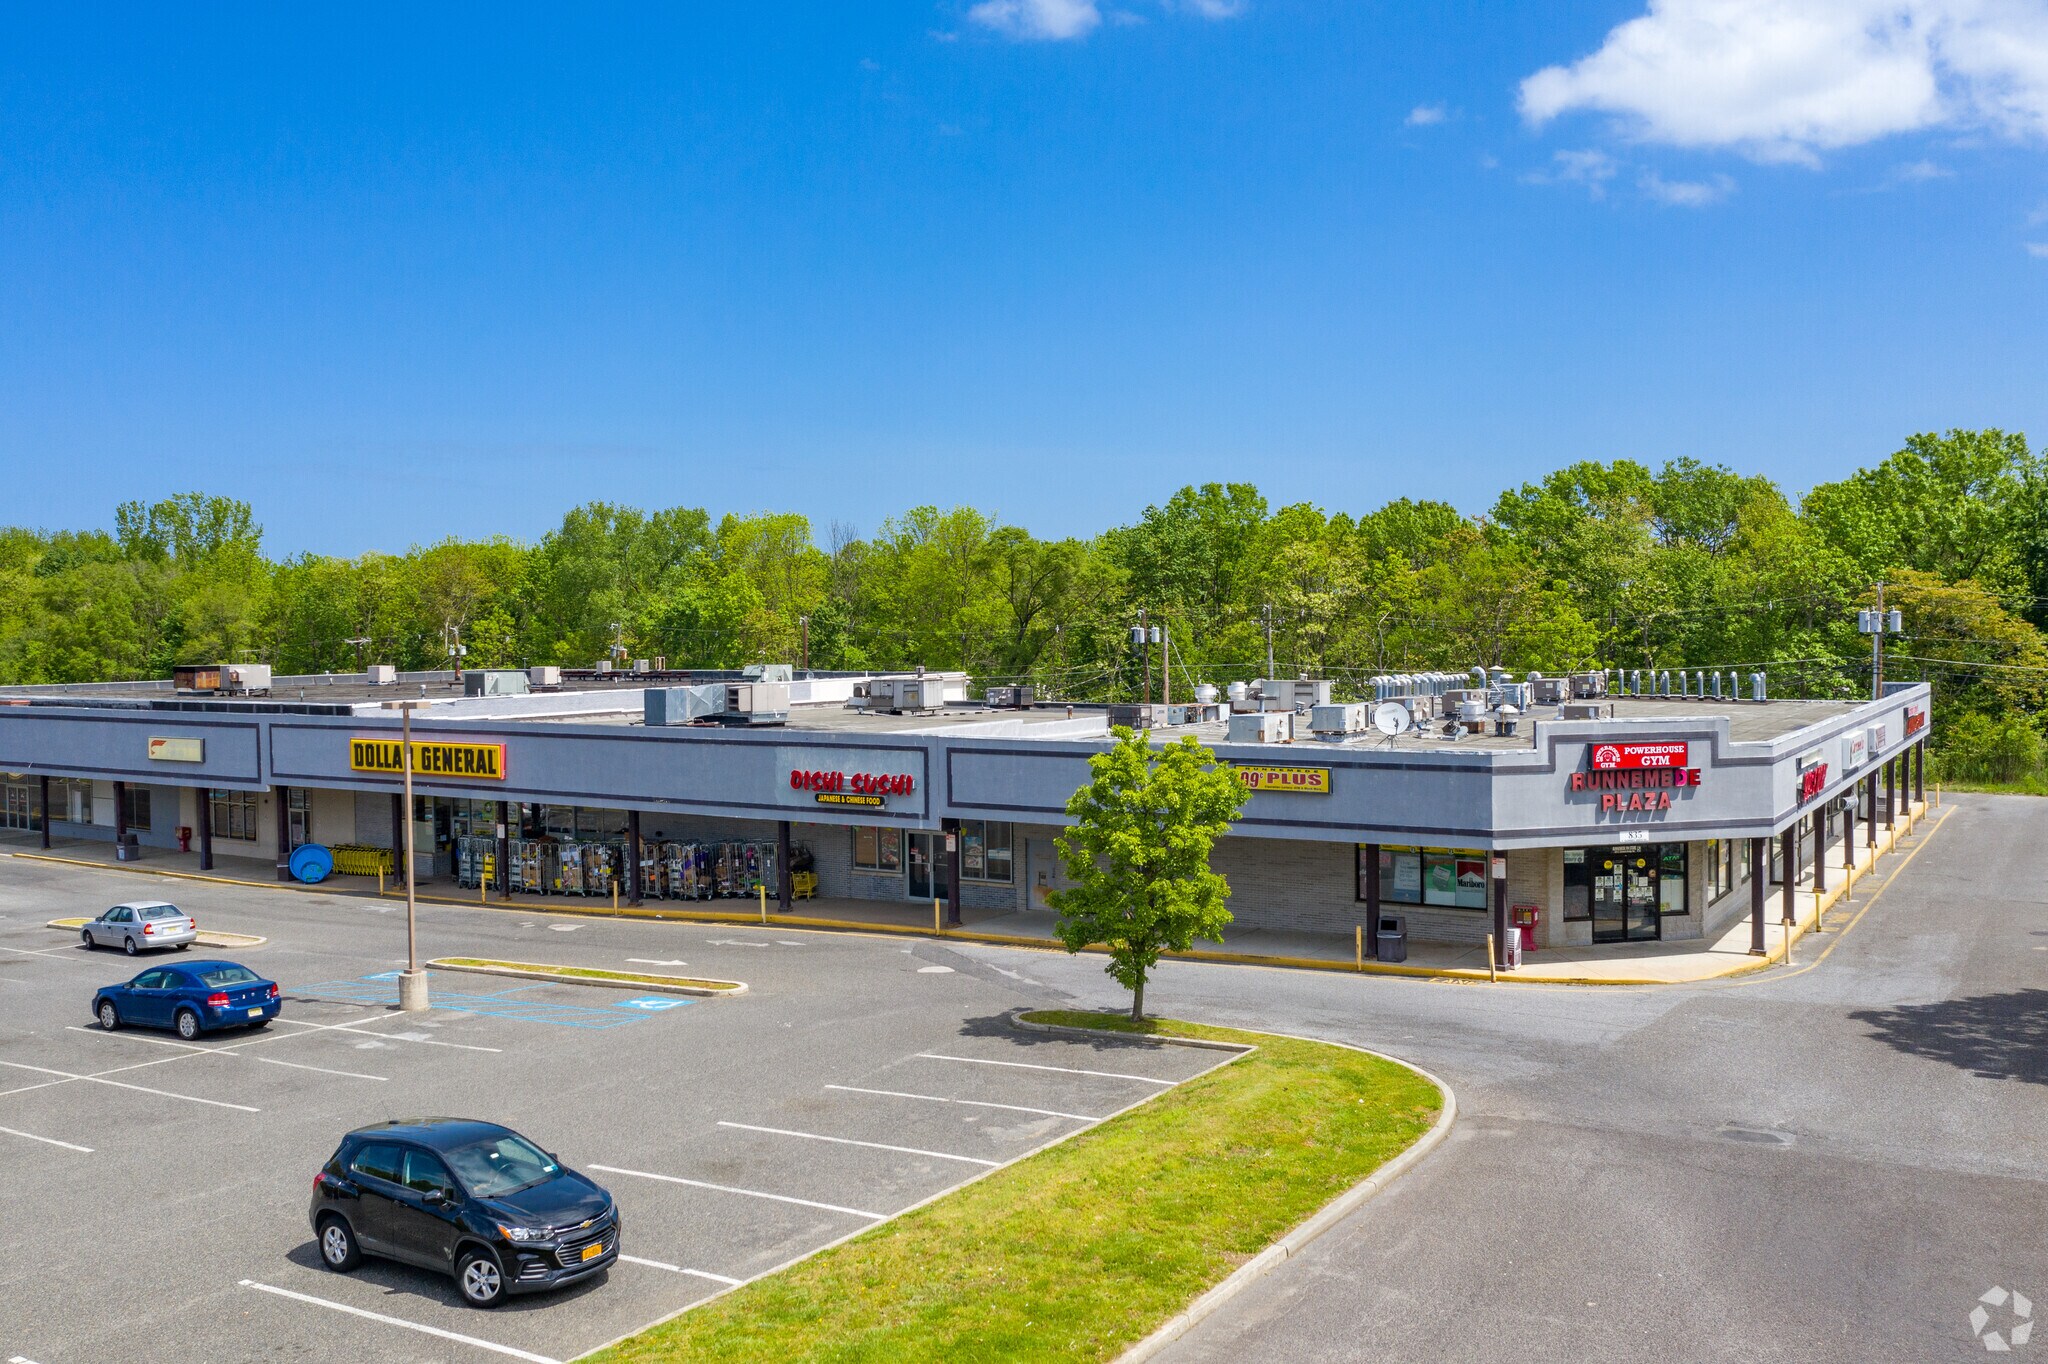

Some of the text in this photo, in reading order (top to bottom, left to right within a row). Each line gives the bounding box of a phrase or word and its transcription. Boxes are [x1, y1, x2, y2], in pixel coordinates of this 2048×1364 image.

[1624, 745, 1685, 755] POWERHOUSE
[421, 746, 496, 774] GENERAL
[1641, 756, 1671, 766] GYM
[790, 769, 914, 796] OISHI SUSHI
[1267, 772, 1322, 786] PLUS
[1571, 768, 1702, 792] RUNNEMEDE
[818, 794, 841, 803] JAPANESE
[846, 796, 865, 804] CHINESE
[866, 796, 881, 805] FOOD
[1601, 791, 1672, 812] PLAZA
[1628, 830, 1643, 839] 835
[1457, 879, 1485, 889] Marlboro
